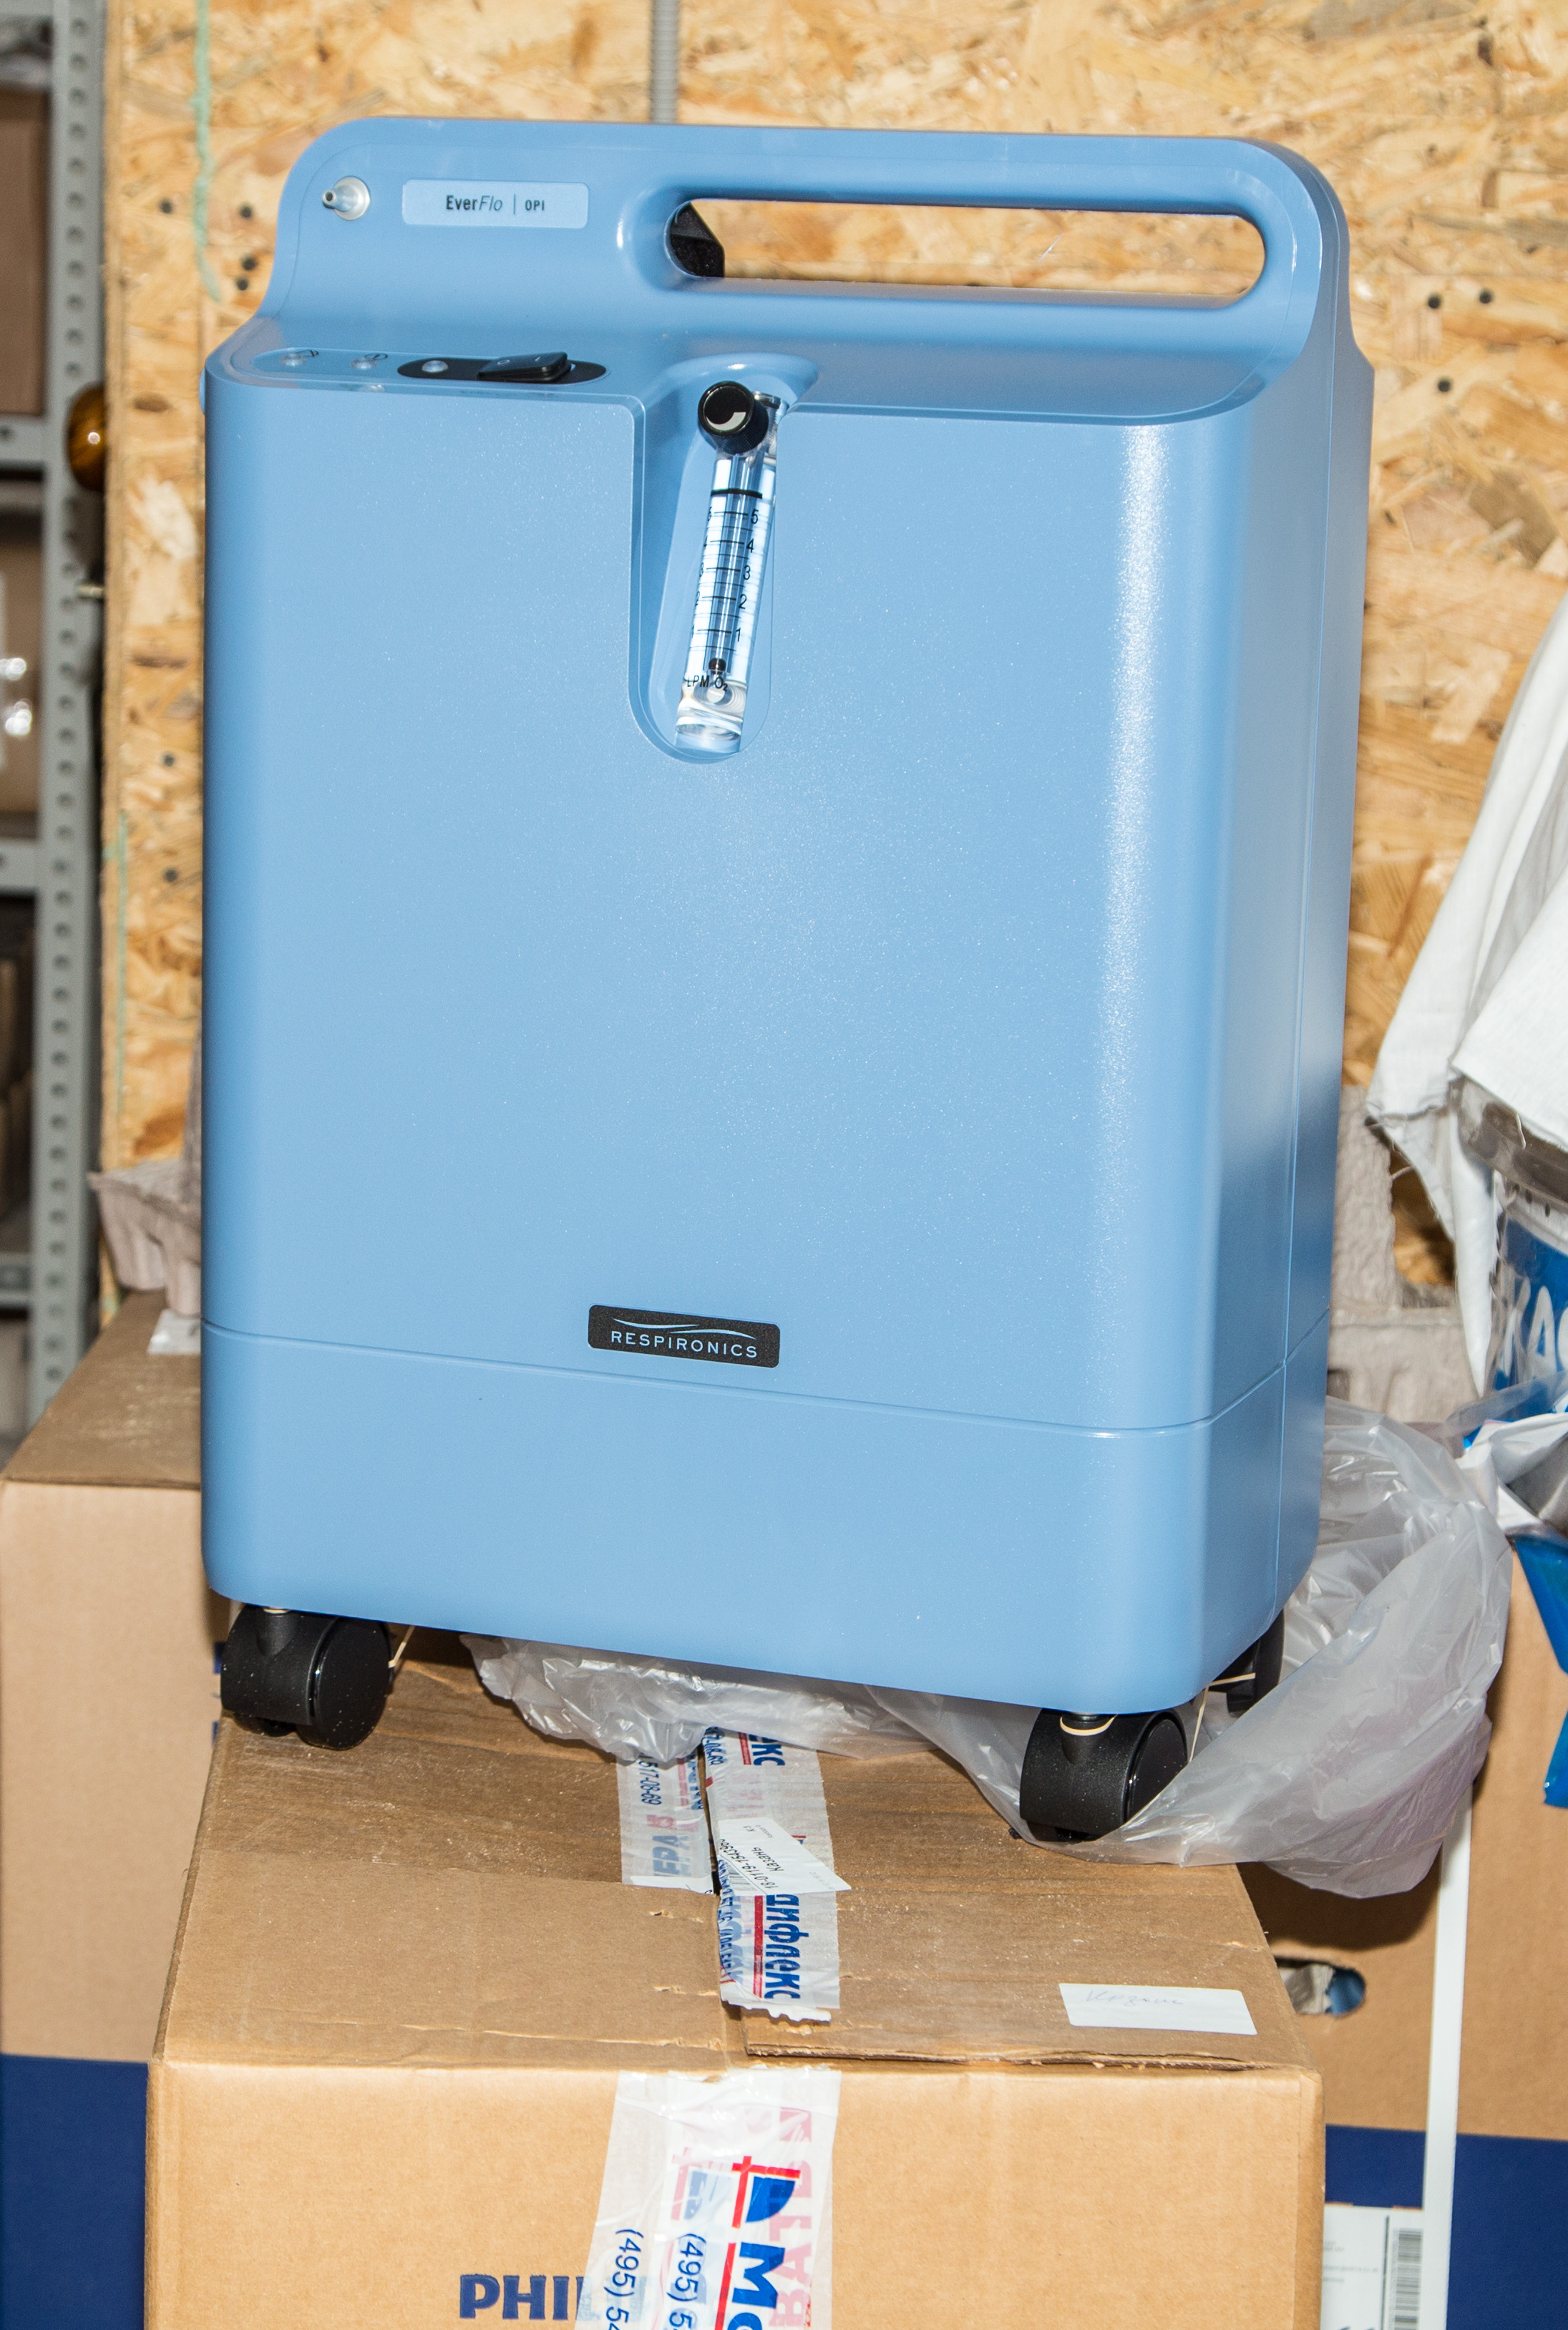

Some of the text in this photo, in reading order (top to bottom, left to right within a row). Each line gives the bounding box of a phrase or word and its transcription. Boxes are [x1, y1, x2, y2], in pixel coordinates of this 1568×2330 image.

[446, 194, 545, 212] EverFlo OPI
[751, 509, 759, 525] 5
[746, 538, 754, 553] 4
[743, 565, 751, 580] 3
[738, 593, 747, 610] 2
[736, 627, 741, 643] 1
[686, 675, 710, 688] LPM
[610, 1330, 757, 1359] RESPIRONICS
[752, 1846, 784, 1873] Казань
[603, 2228, 644, 2297] (495)
[666, 2232, 707, 2304] (495)
